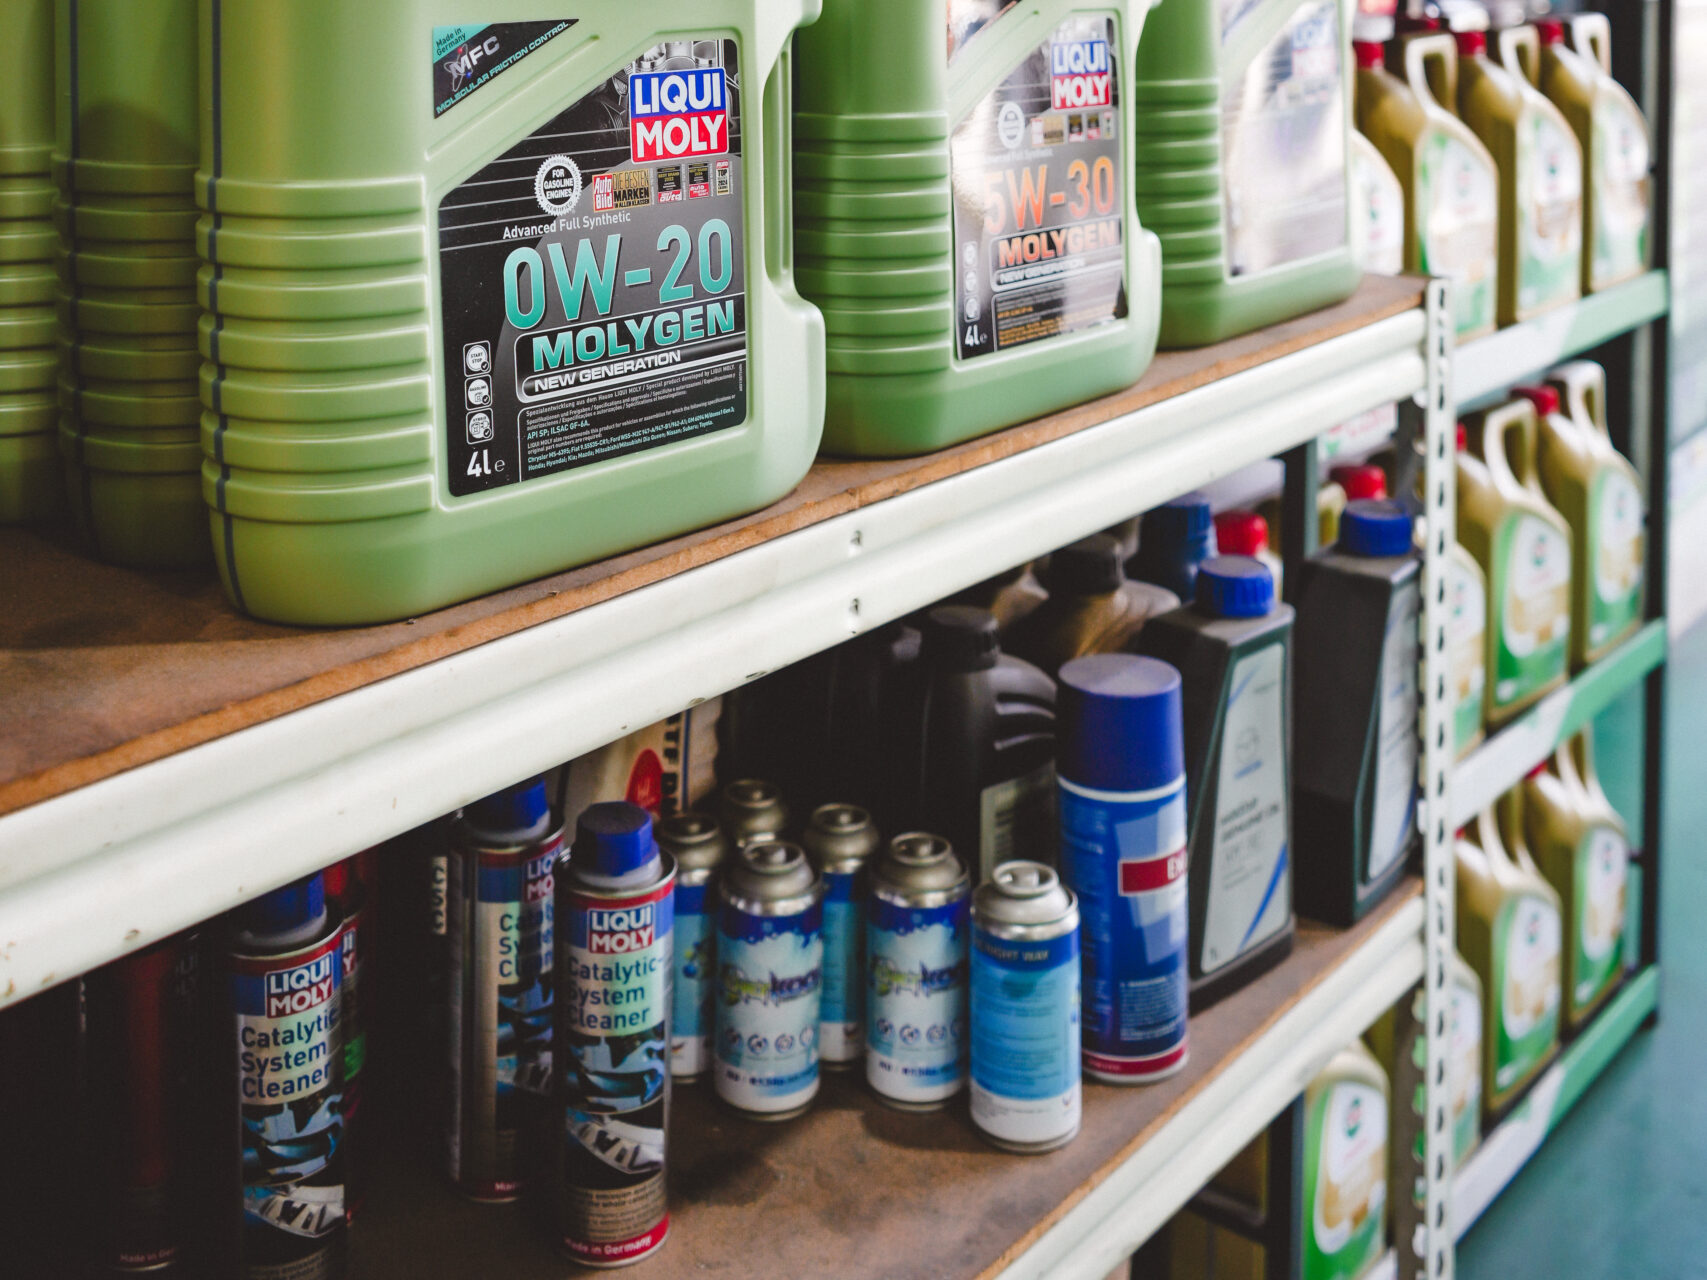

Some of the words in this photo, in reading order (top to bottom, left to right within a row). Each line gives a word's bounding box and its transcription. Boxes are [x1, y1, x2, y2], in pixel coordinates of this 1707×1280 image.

[436, 32, 454, 47] Made
[436, 33, 466, 56] Germany
[436, 72, 489, 114] MOLECULAR
[489, 47, 528, 77] FRICTION
[528, 22, 569, 50] CONTROL
[449, 36, 500, 79] MFC
[1053, 42, 1106, 74] LIQUI
[635, 72, 723, 114] LIQUI
[1054, 74, 1109, 108] MOLY
[636, 113, 726, 159] MOLY
[543, 177, 574, 190] GASOLINE
[552, 168, 564, 178] FOR
[594, 177, 612, 194] Auto
[613, 173, 623, 190] DIE
[625, 169, 649, 188] BESTEN
[546, 188, 572, 199] ENGINES
[595, 192, 612, 209] Bild
[613, 187, 649, 202] MARKEN
[985, 156, 1115, 234] 5W-30
[503, 221, 557, 240] Advanced
[559, 218, 580, 232] Full
[584, 212, 631, 230] Synthetic
[999, 223, 1117, 267] MOLYGEN
[503, 218, 733, 330] 0W-20
[532, 300, 735, 372] MOLYGEN
[534, 372, 578, 392] NEW
[579, 349, 682, 384] GENERATION
[614, 388, 627, 397] LIQUI
[628, 385, 641, 393] MOLY
[646, 380, 662, 389] Special
[663, 376, 680, 385] product
[526, 430, 537, 440] API
[538, 427, 549, 437] SP;
[550, 423, 568, 434] ILSAC
[527, 441, 539, 449] LIQUI
[540, 438, 552, 446] MOLY
[527, 452, 548, 463] Chrysler
[591, 907, 651, 932] LIQUI
[591, 928, 653, 953] MOLY
[270, 958, 331, 995] LIQUI
[270, 982, 331, 1017] MOLY
[568, 982, 645, 1007] System
[568, 1006, 650, 1030] Cleaner
[241, 1041, 327, 1078] System
[241, 1061, 331, 1098] Cleaner
[603, 1235, 652, 1256] Germany
